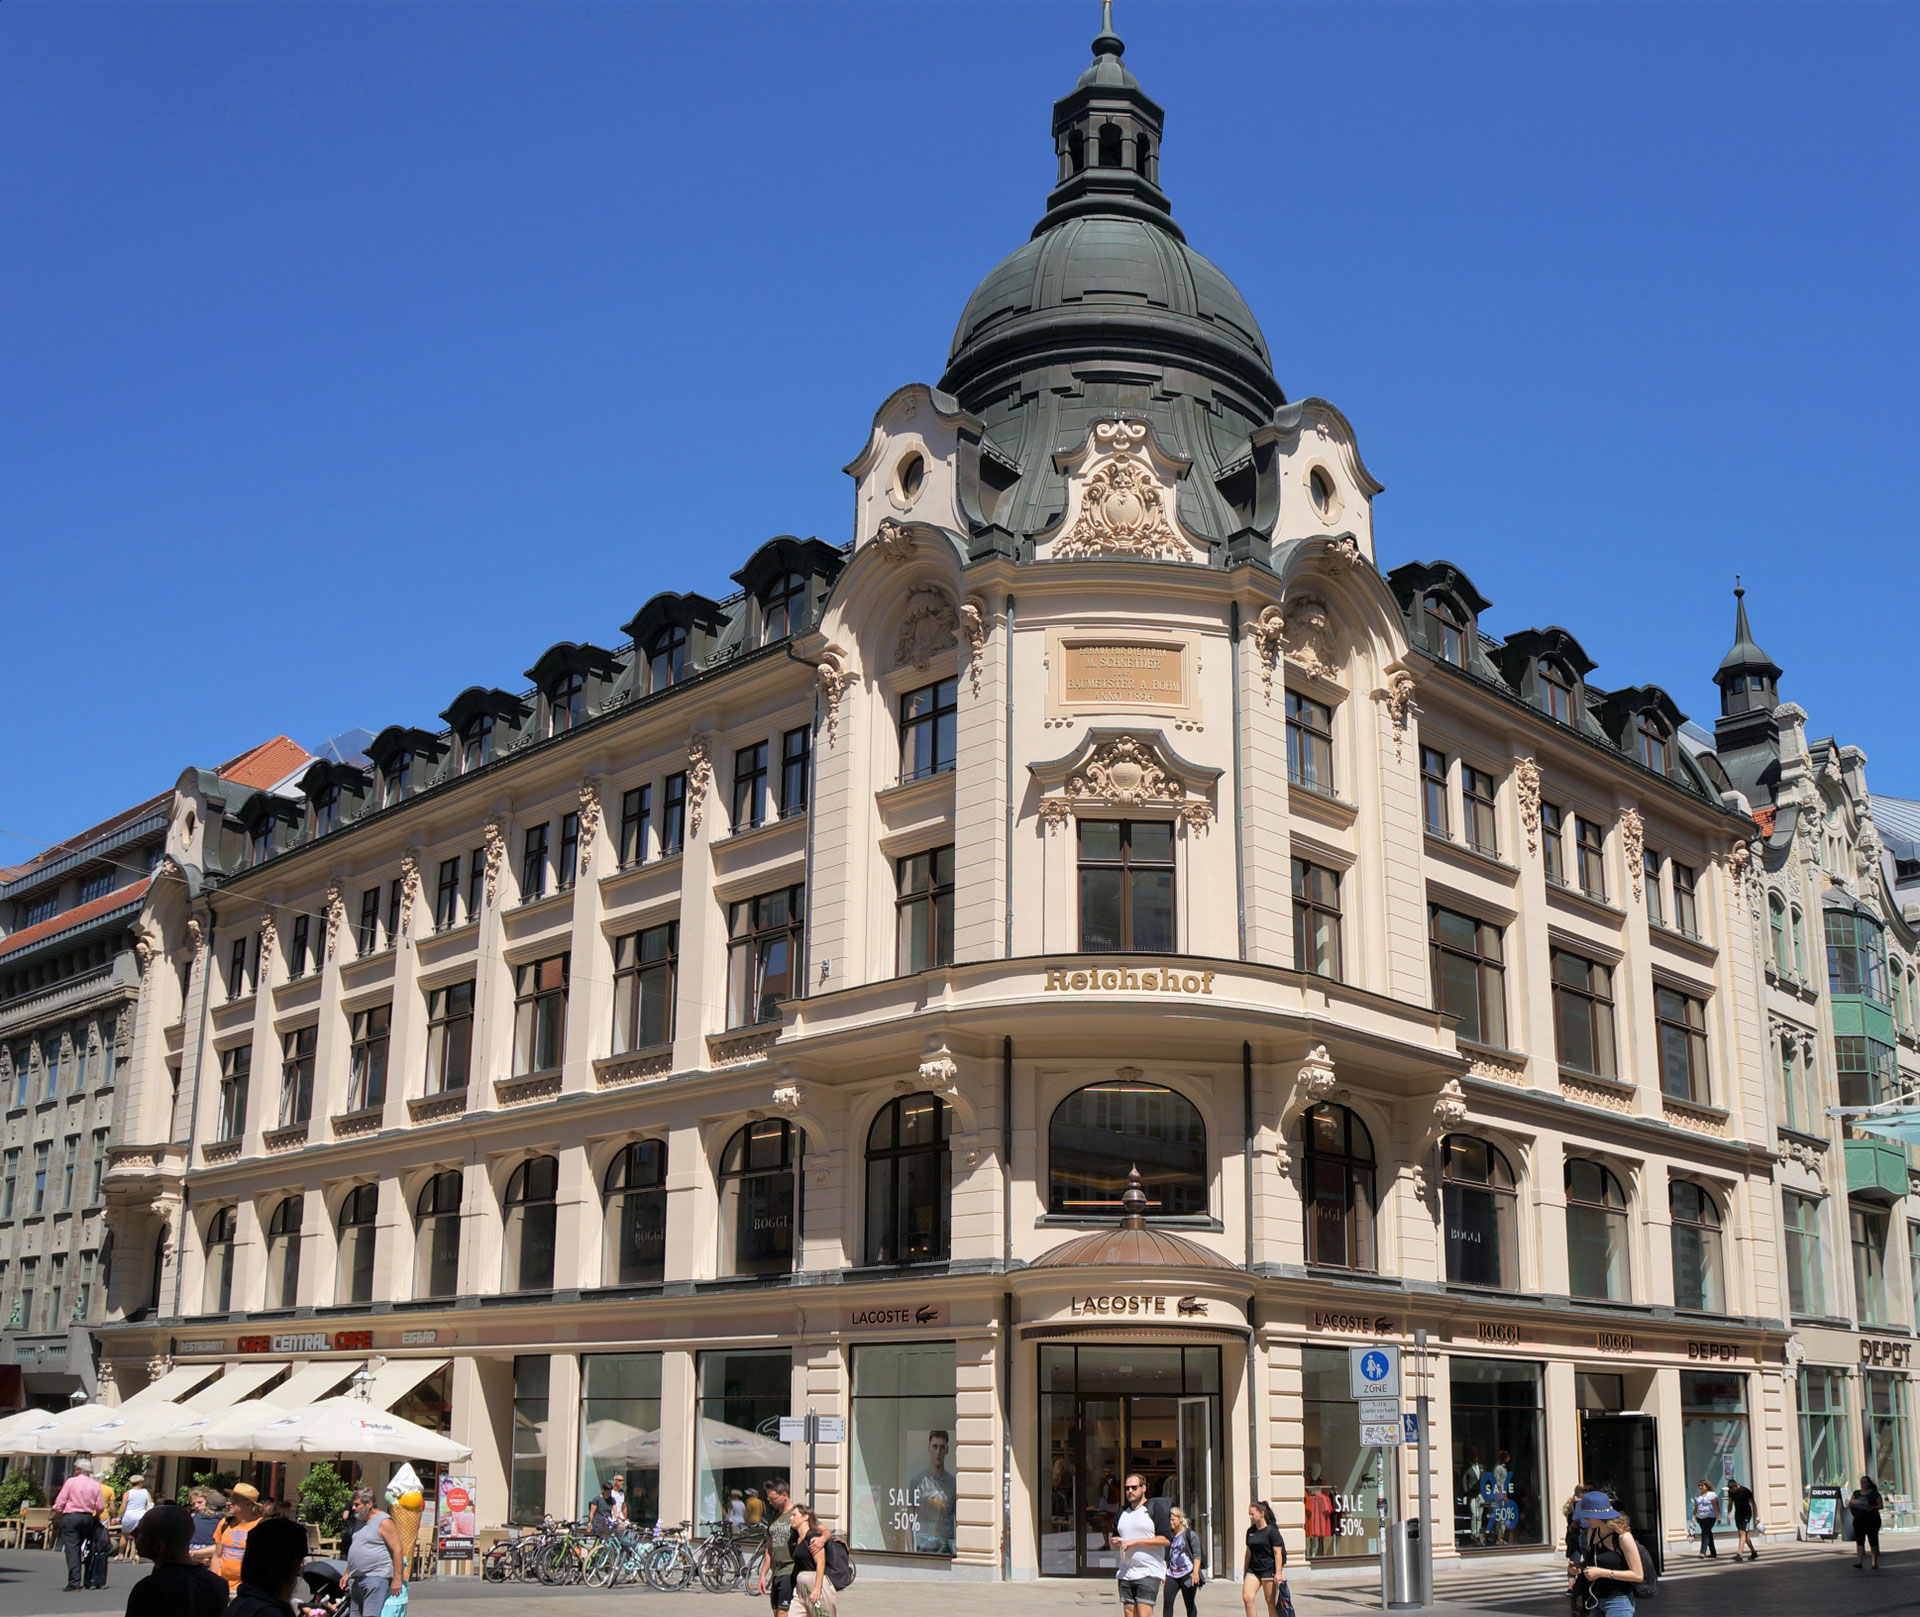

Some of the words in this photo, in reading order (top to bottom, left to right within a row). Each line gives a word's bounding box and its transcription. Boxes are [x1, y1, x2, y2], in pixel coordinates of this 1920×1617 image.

[1099, 657, 1161, 670] SCHNEIDER
[1067, 679, 1135, 690] BAUMEISTER
[1093, 692, 1121, 701] ANNO
[1043, 966, 1216, 994] Reichshof
[754, 1215, 788, 1230] BOGGI
[1450, 1227, 1481, 1243] BOGGI
[1071, 1296, 1166, 1311] LACOSTE
[852, 1309, 909, 1324] LACOSTE
[1315, 1312, 1369, 1330] LACOSTE
[401, 1330, 436, 1344] EISBAR
[1478, 1322, 1520, 1341] BOGGI
[272, 1333, 331, 1352] CENTRAL
[1597, 1332, 1634, 1350] BOGGI
[1688, 1342, 1740, 1361] DEPOT
[1858, 1339, 1912, 1364] DEPOT
[1363, 1384, 1388, 1393] ZONE
[1485, 1483, 1515, 1495] SALE
[889, 1488, 920, 1507] SALE
[1335, 1494, 1364, 1512] SALE
[889, 1512, 920, 1531] -50%
[1495, 1506, 1516, 1522] 50%
[1335, 1518, 1364, 1536] -50%
[439, 1538, 473, 1549] CENTRAL
